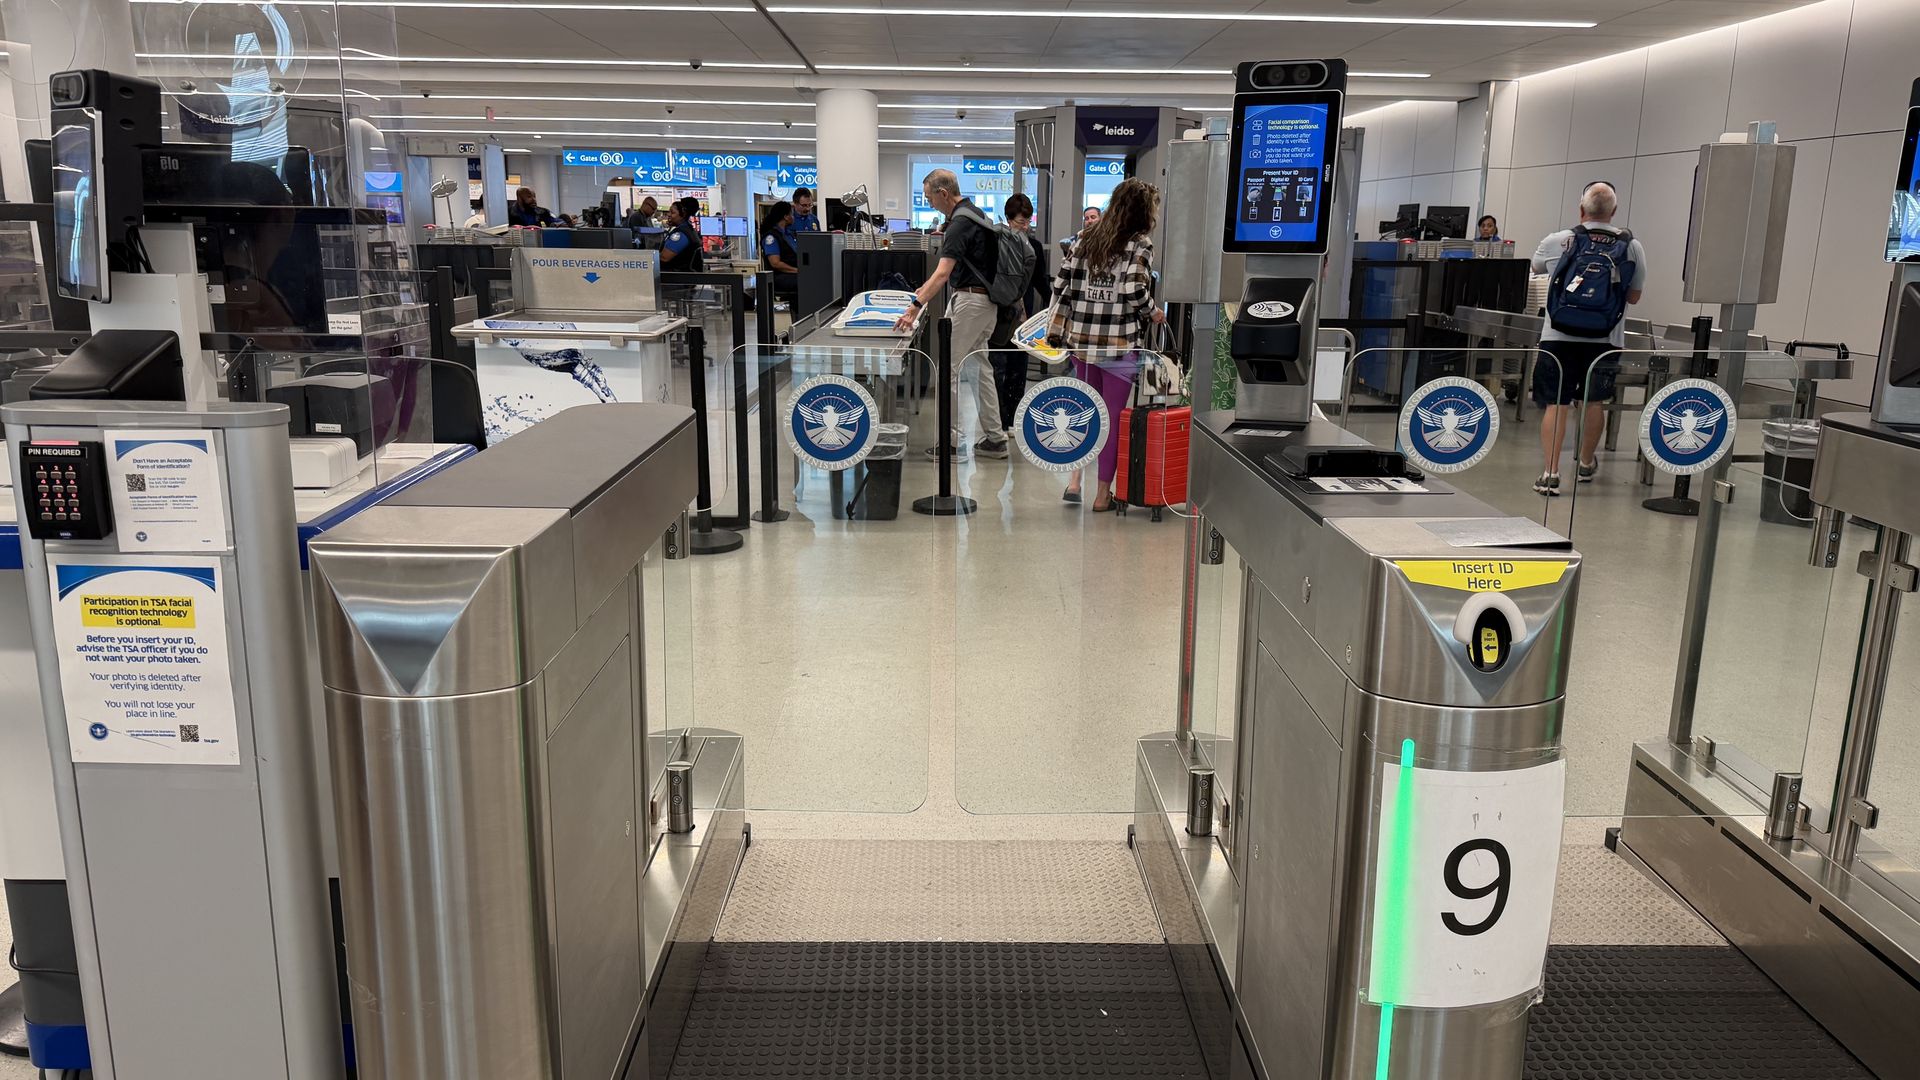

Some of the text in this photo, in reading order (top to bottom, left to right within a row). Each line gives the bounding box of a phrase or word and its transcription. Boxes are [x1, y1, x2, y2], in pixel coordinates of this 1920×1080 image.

[1105, 126, 1135, 136] leidos
[1089, 164, 1106, 172] Gates
[1061, 170, 1066, 179] 7
[934, 246, 938, 255] 7
[532, 258, 649, 269] POUR BEVERAGES HERE
[1088, 288, 1114, 300] THAT
[784, 376, 878, 431] TRANSPORTATION SECURITY
[1015, 379, 1108, 432] TRANSPORTATION SECURITY
[1401, 378, 1498, 432] TRANSPORTATION SECURITY
[1641, 380, 1736, 434] TRANSPORTATION SECURITY
[789, 441, 871, 469] ADMINISTRATION
[1020, 445, 1101, 472] ADMINISTRATION
[1405, 444, 1489, 472] ADMINISTRATION
[1645, 447, 1725, 474] ADMINISTRATION
[1452, 562, 1514, 574] Insert ID
[1467, 578, 1502, 589] Here
[84, 598, 138, 606] Participation
[140, 598, 148, 606] in
[169, 599, 192, 607] facial
[90, 608, 187, 618] recognition technology
[116, 617, 163, 626] is optional.
[87, 635, 115, 643] Before
[136, 636, 160, 644] insert
[184, 637, 196, 645] ID,
[122, 645, 139, 653] TSA
[141, 645, 168, 654] officer
[196, 646, 208, 654] do
[148, 655, 173, 663] photo
[90, 673, 201, 682] Your photo is deleted after
[111, 682, 185, 692] verifying identity.
[105, 700, 121, 708] You
[124, 700, 138, 708] will
[175, 702, 195, 710] your
[126, 710, 177, 718] place in line.
[1441, 838, 1511, 936] 9
